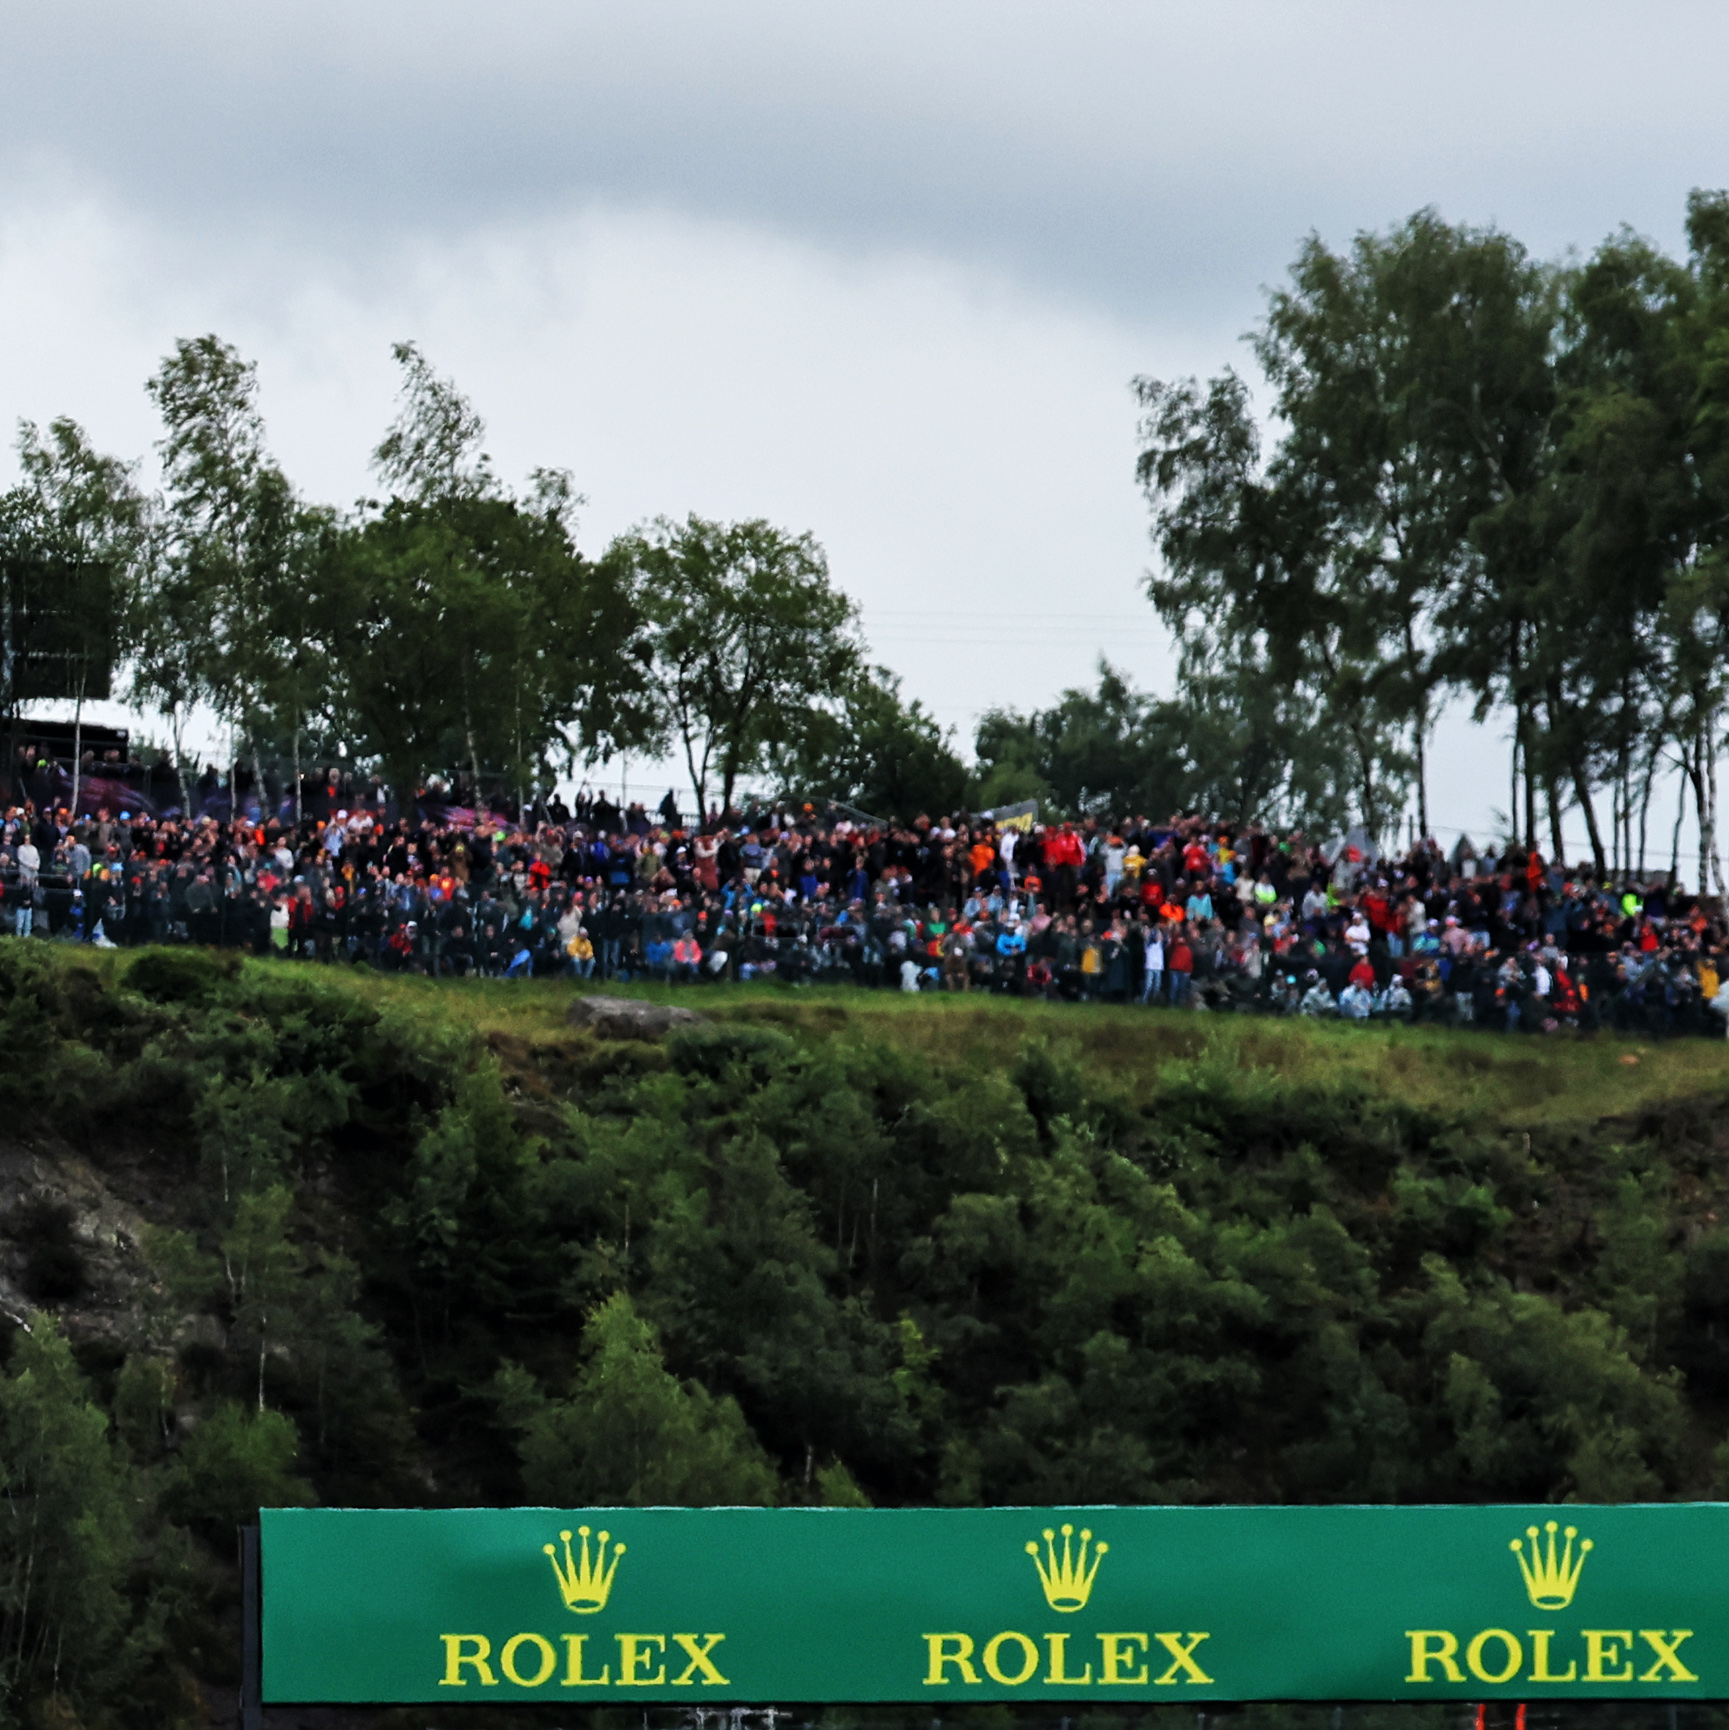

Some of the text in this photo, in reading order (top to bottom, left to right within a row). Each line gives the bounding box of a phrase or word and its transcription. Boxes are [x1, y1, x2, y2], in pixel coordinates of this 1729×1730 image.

[438, 1633, 730, 1687] ROLEX
[923, 1631, 1214, 1685] ROLEX
[1406, 1629, 1698, 1684] ROLEX
